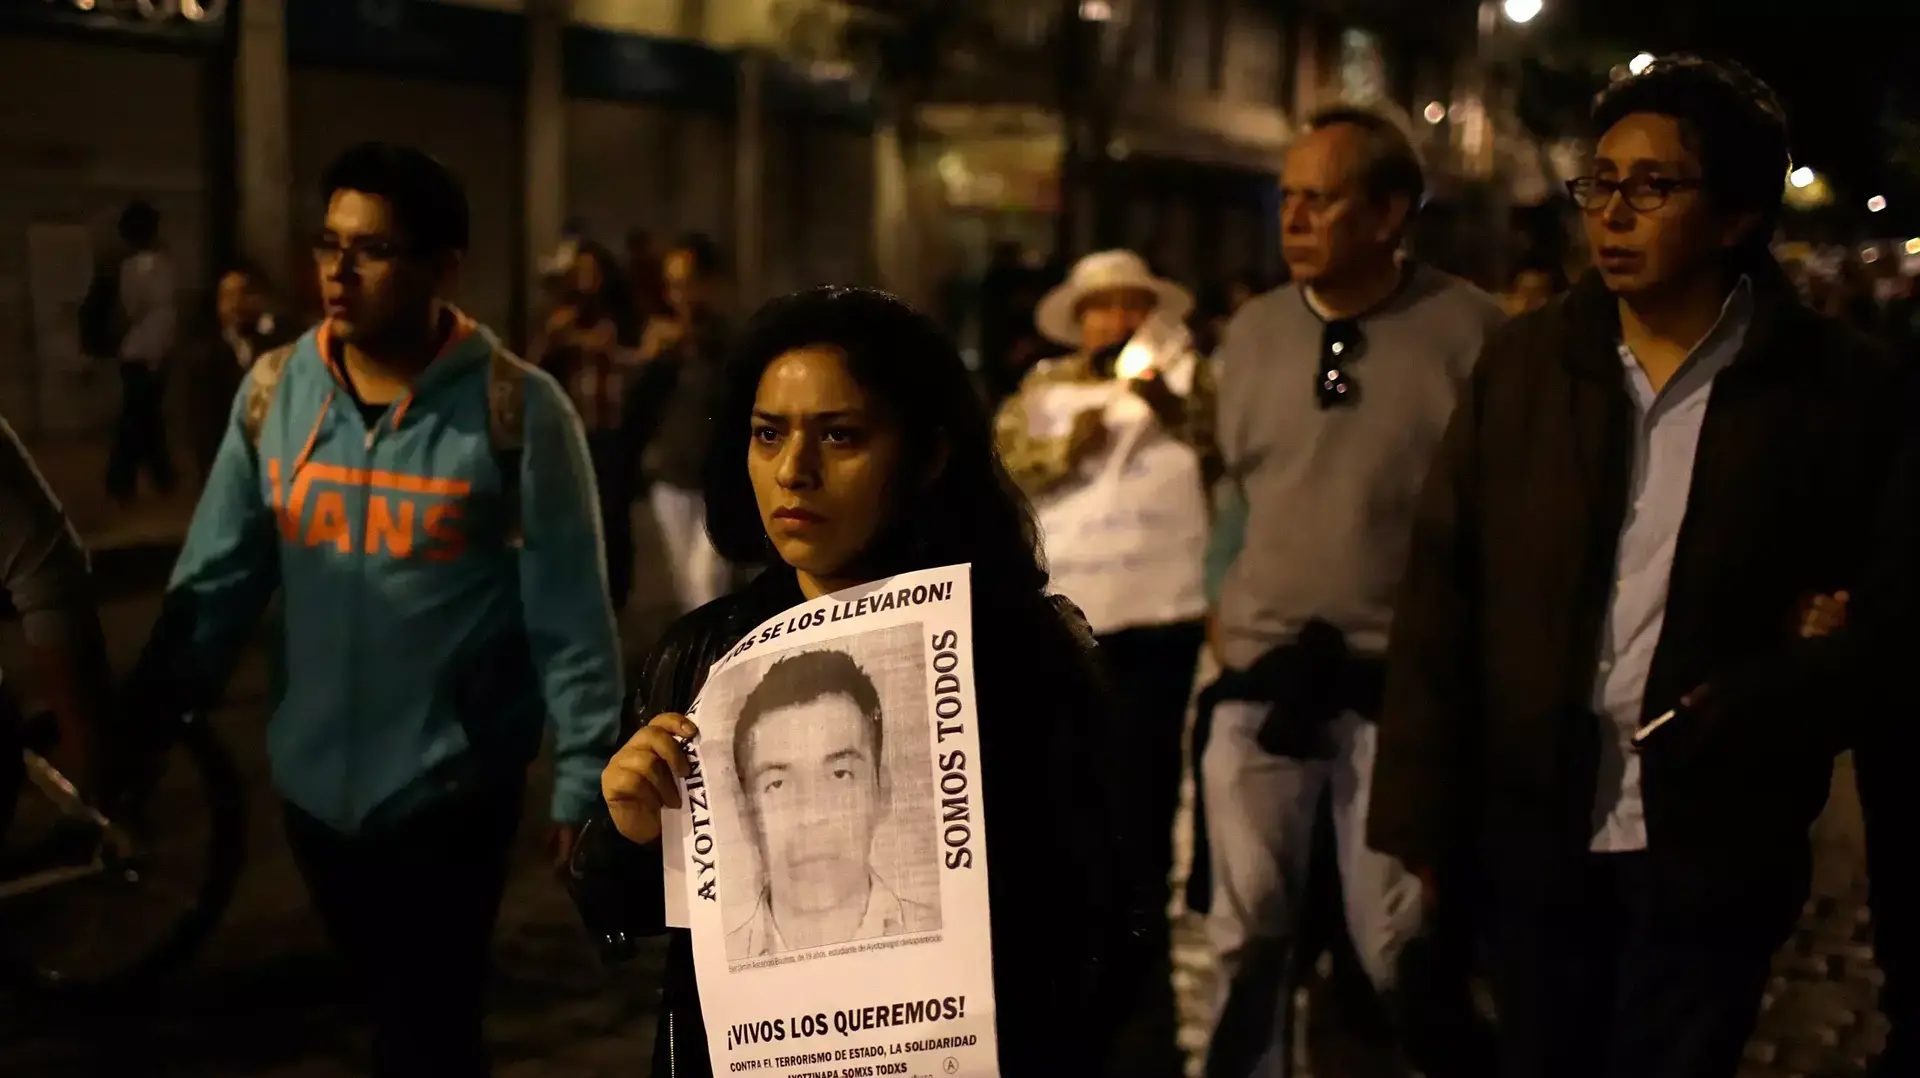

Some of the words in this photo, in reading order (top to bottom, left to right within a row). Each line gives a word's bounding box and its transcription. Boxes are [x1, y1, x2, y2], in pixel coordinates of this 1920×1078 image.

[268, 457, 472, 561] VANS
[759, 621, 784, 643] SE
[786, 608, 826, 634] LOS
[830, 581, 953, 623] LLEVARON!
[931, 629, 964, 743] TODOS
[939, 749, 973, 869] SOMOS
[858, 943, 866, 952] de
[727, 1018, 786, 1050] ¡VIVOS
[790, 1013, 829, 1039] LOS
[833, 996, 966, 1037] QUEREMOS!
[730, 1059, 761, 1073] CONTRA
[774, 1051, 832, 1069] TERRORISMO
[834, 1049, 847, 1061] DE
[849, 1045, 887, 1060] ESTADO,
[889, 1043, 902, 1055] LA
[904, 1034, 977, 1053] SOLIDARIDAD
[841, 1066, 873, 1078] SOMXS
[875, 1062, 908, 1076] TODXS
